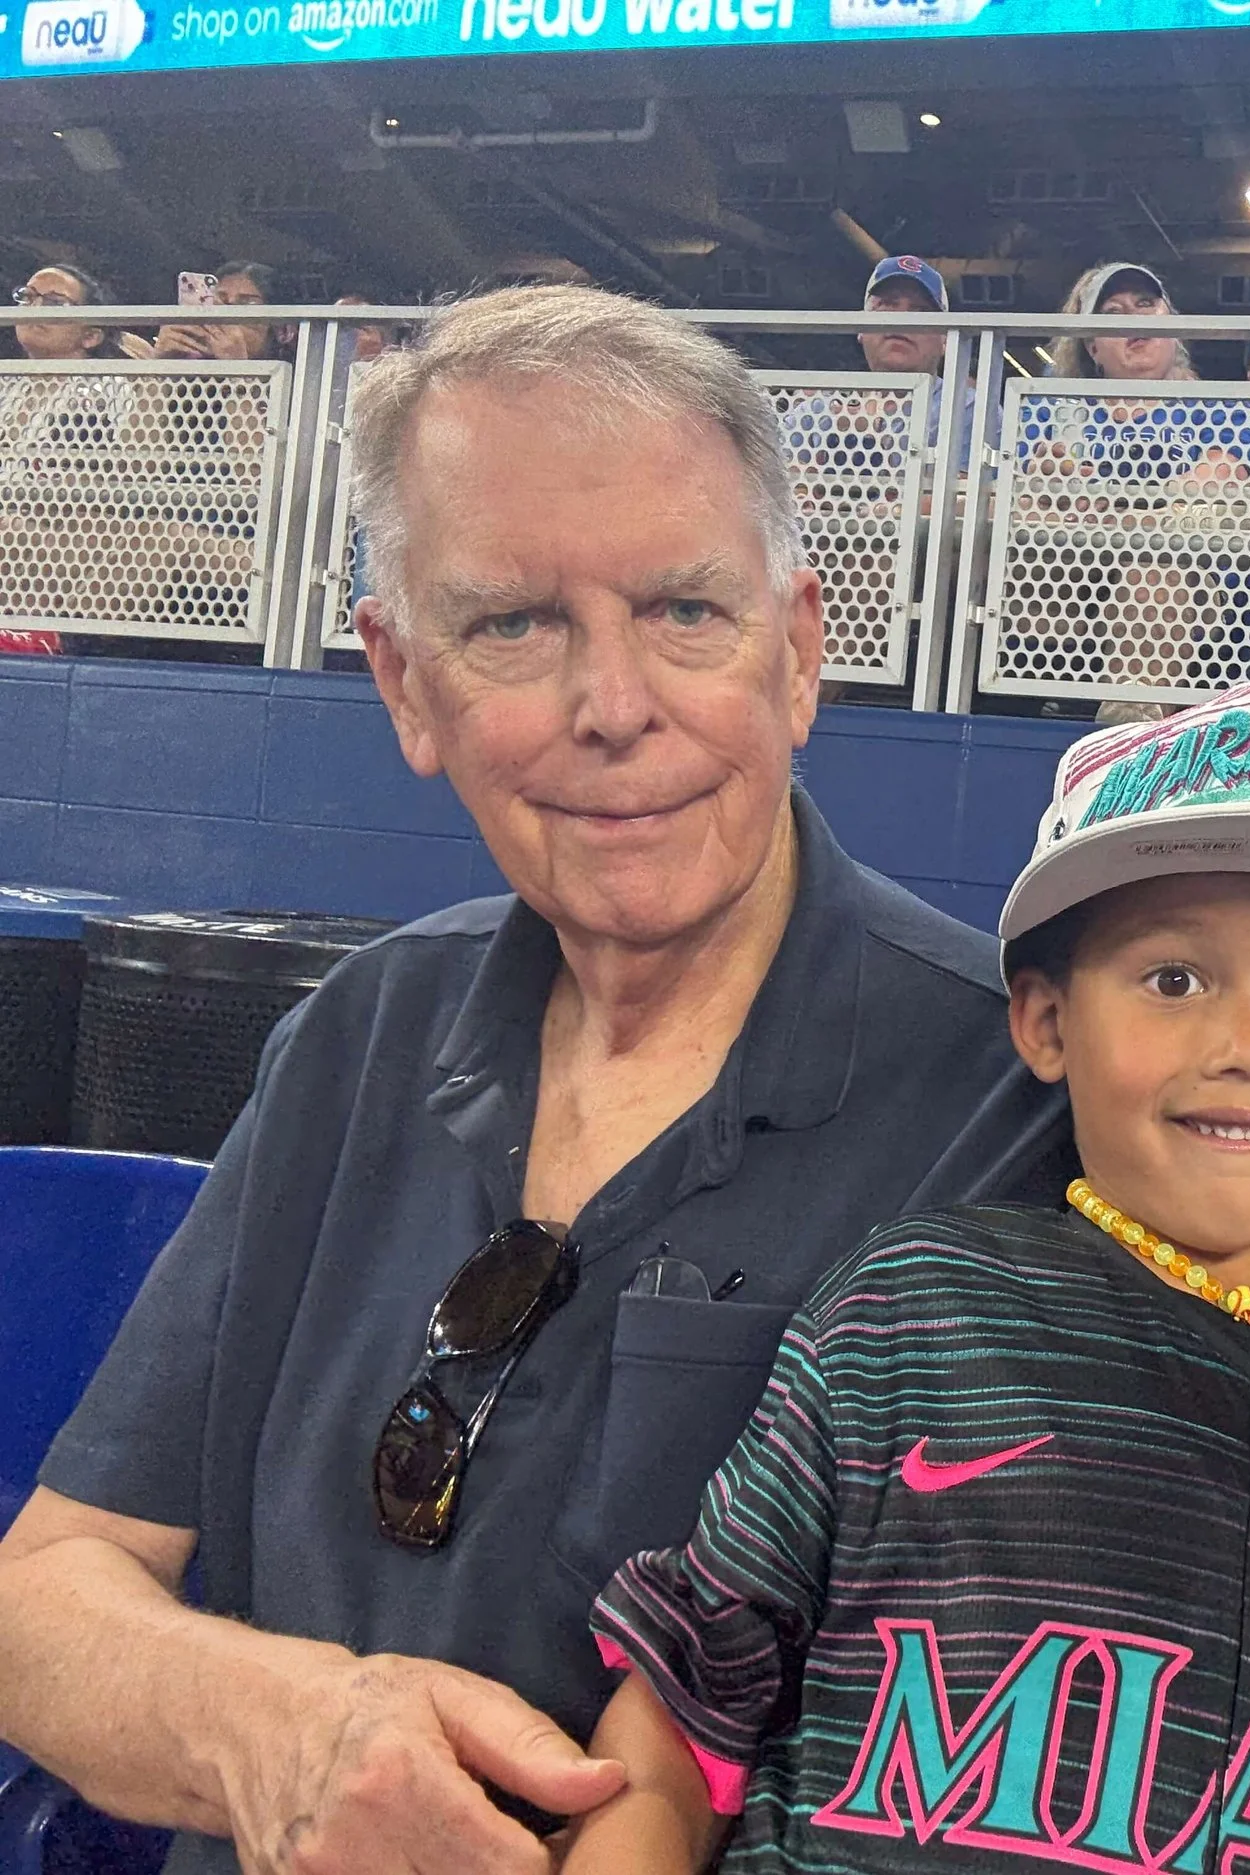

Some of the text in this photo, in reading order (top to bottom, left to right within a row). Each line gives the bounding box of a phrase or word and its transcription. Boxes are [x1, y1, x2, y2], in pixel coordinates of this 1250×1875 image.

[171, 0, 438, 45] shop on amazon.com
